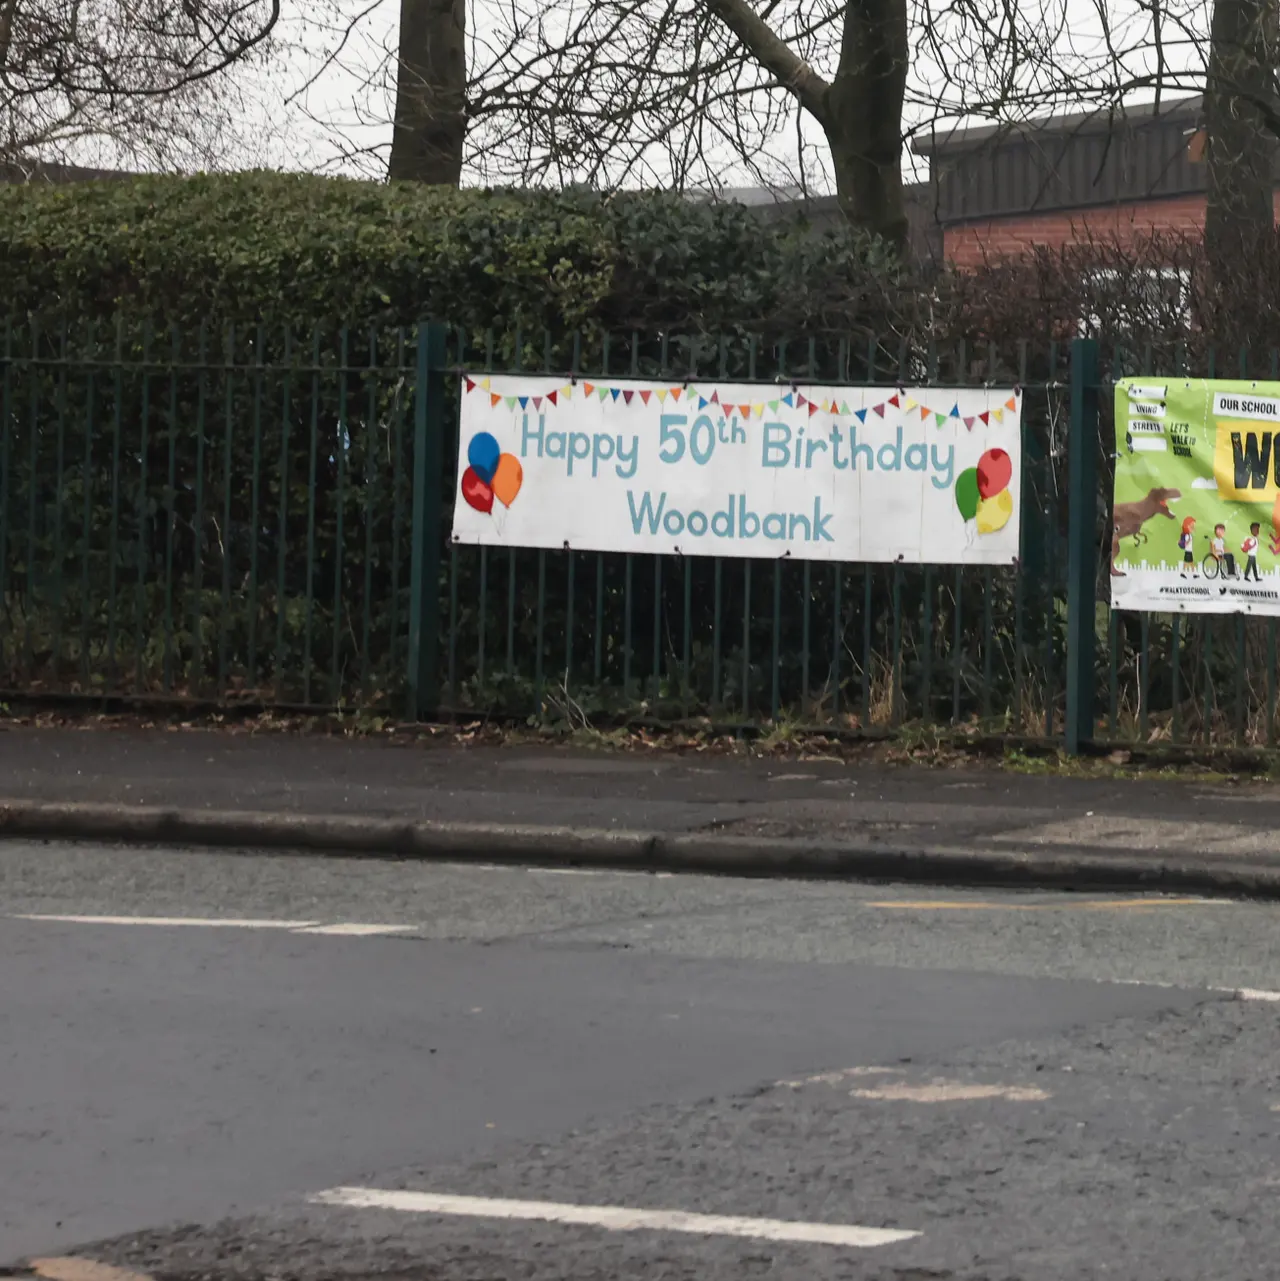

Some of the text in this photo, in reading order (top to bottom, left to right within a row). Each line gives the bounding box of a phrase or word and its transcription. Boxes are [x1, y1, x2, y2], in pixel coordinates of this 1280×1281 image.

[1219, 397, 1239, 411] OUR
[1241, 400, 1277, 416] SCHOOL
[521, 413, 955, 490] Happy 50th Birthday
[627, 491, 835, 542] Woodbank
